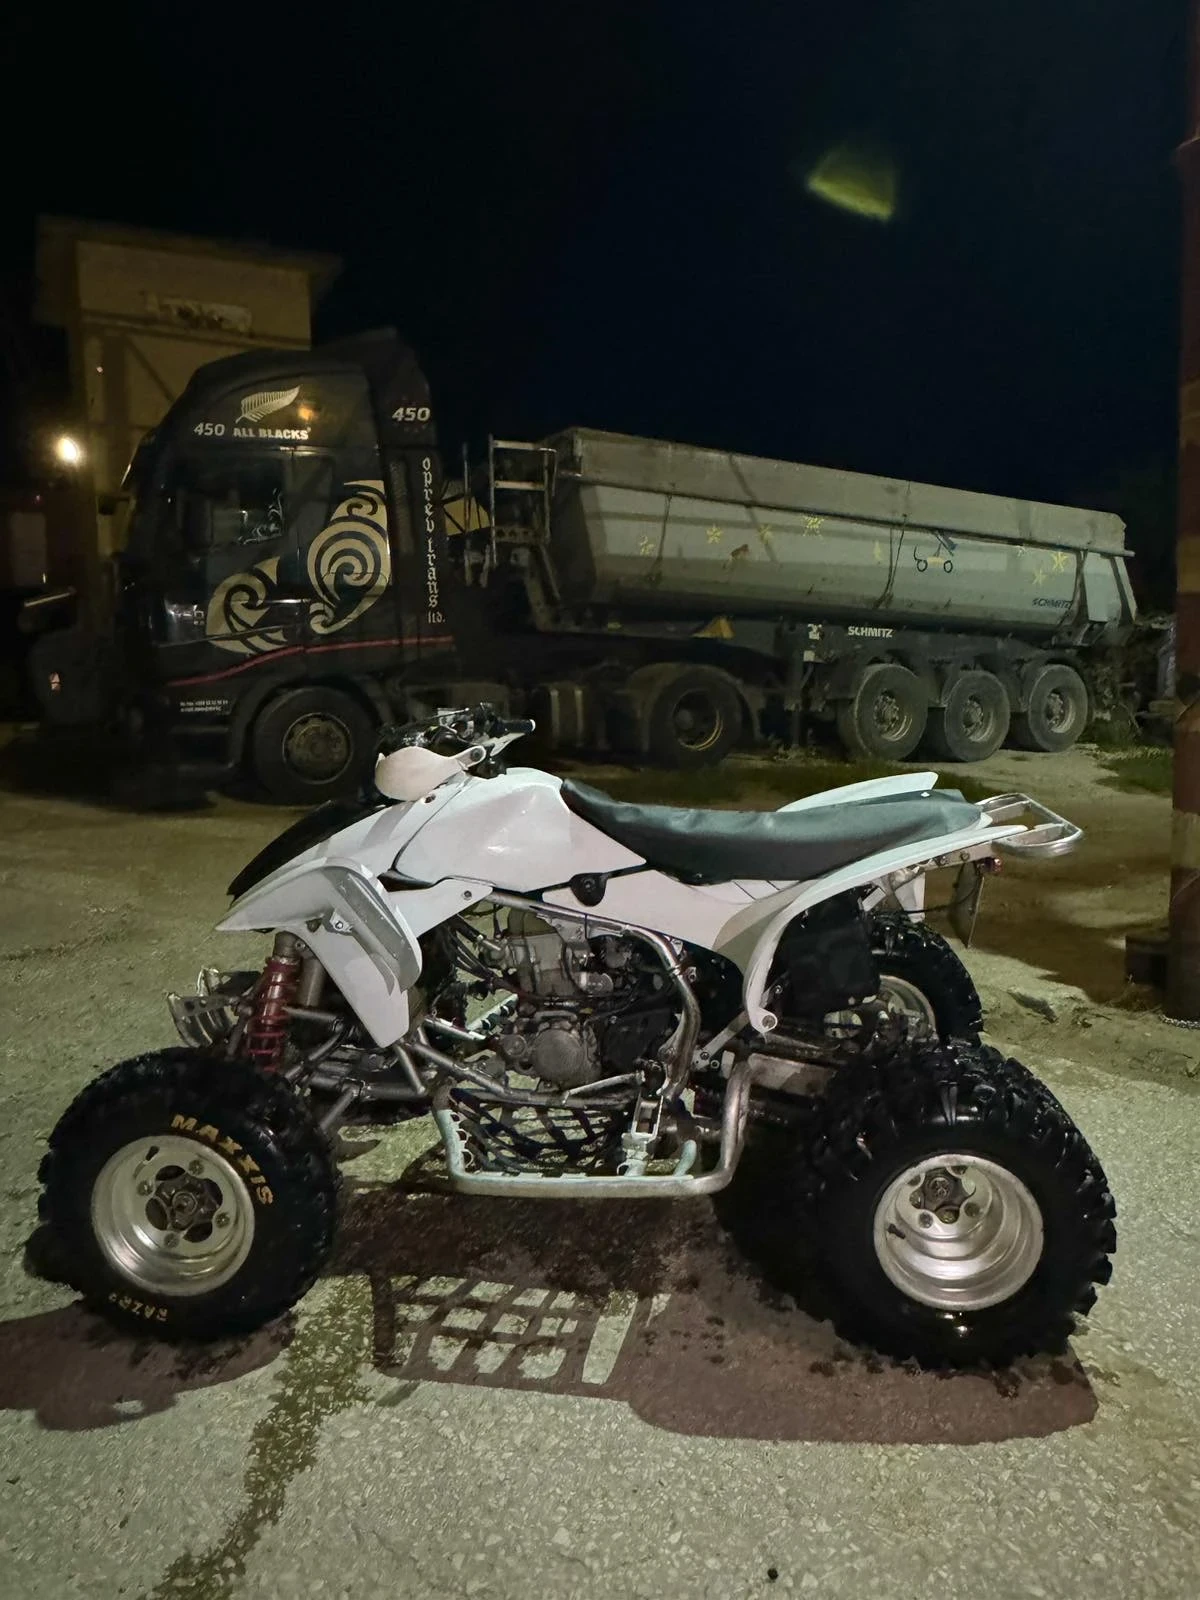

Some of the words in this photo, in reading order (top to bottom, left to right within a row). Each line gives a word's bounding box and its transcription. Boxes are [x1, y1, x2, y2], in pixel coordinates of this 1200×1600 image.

[392, 406, 431, 421] 450
[193, 422, 225, 437] 450
[233, 427, 256, 438] ALL
[259, 428, 311, 441] BLACKS
[426, 536, 439, 608] trans
[847, 625, 894, 638] SCHMITZ
[171, 1113, 274, 1205] MAXXIS
